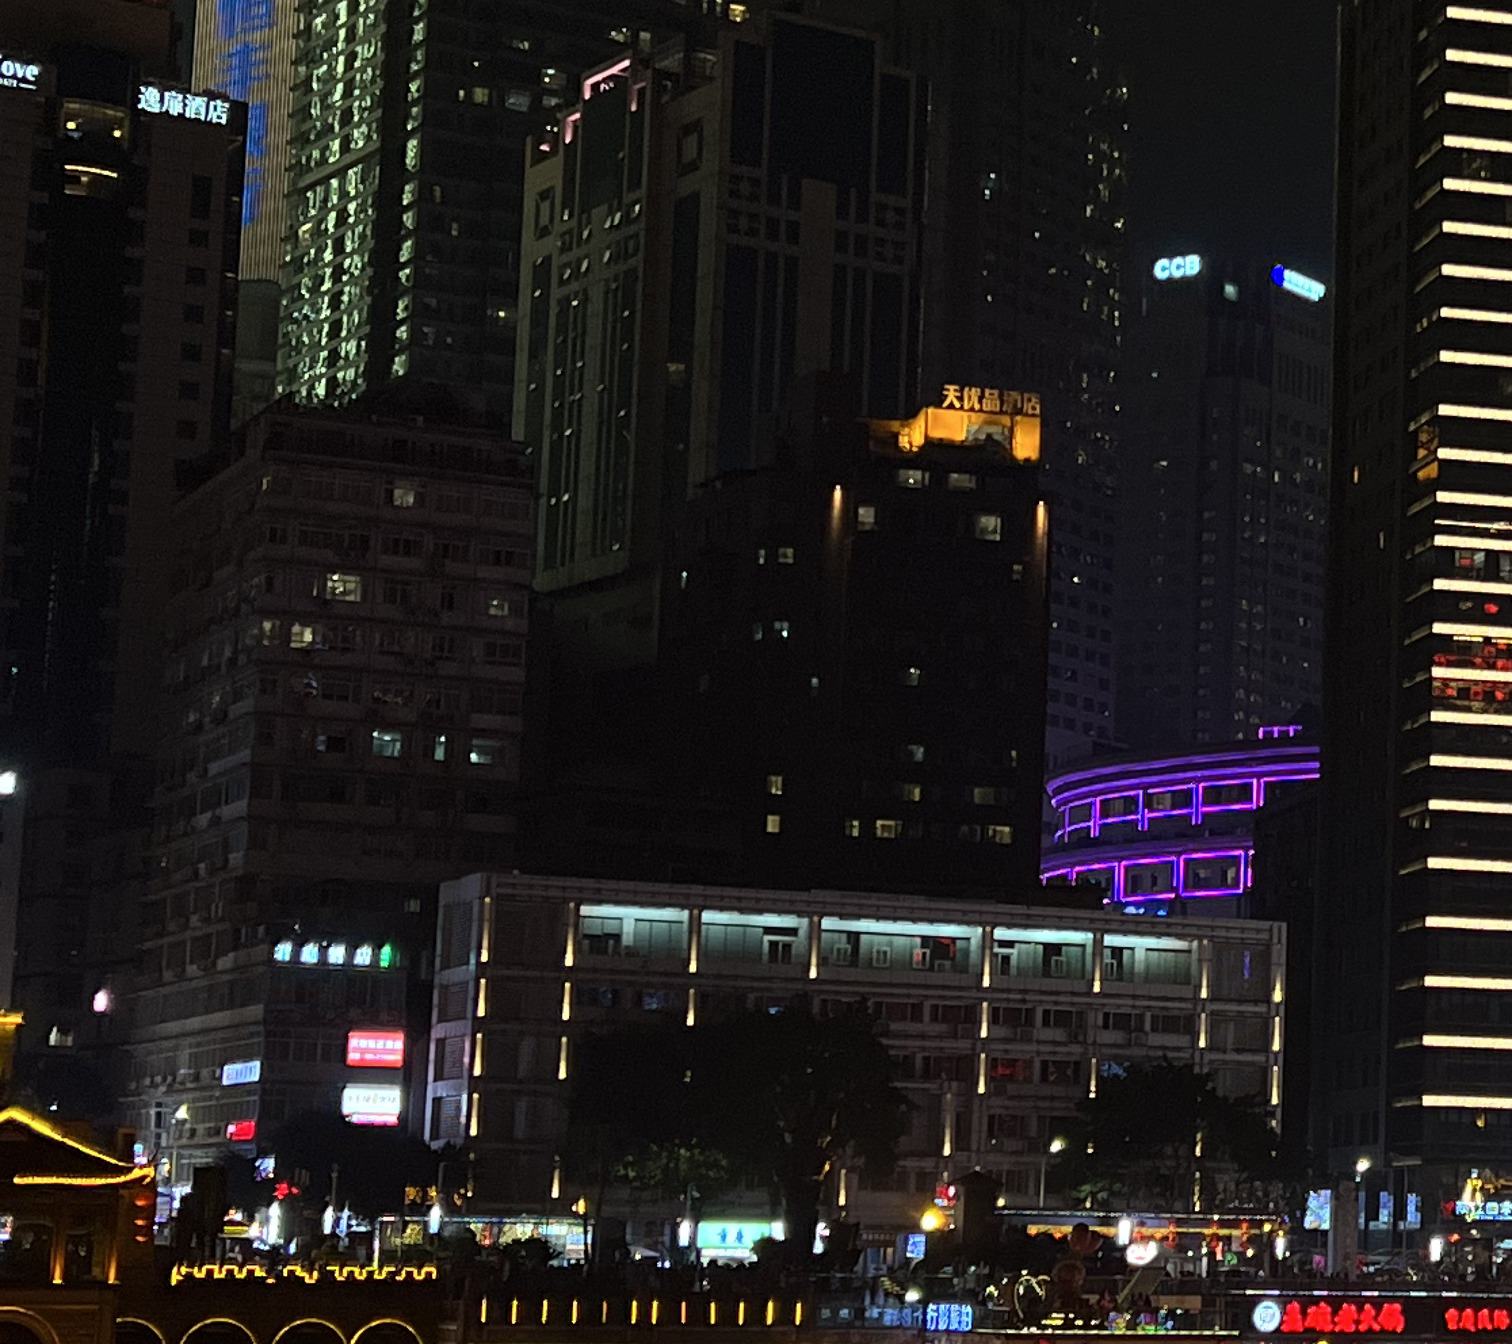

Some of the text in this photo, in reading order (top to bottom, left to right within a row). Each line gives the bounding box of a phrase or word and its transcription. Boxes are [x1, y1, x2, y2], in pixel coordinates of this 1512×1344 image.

[137, 85, 231, 126] 逸扉酒店
[1153, 253, 1201, 281] CCB
[941, 384, 1042, 414] 天优品酒店
